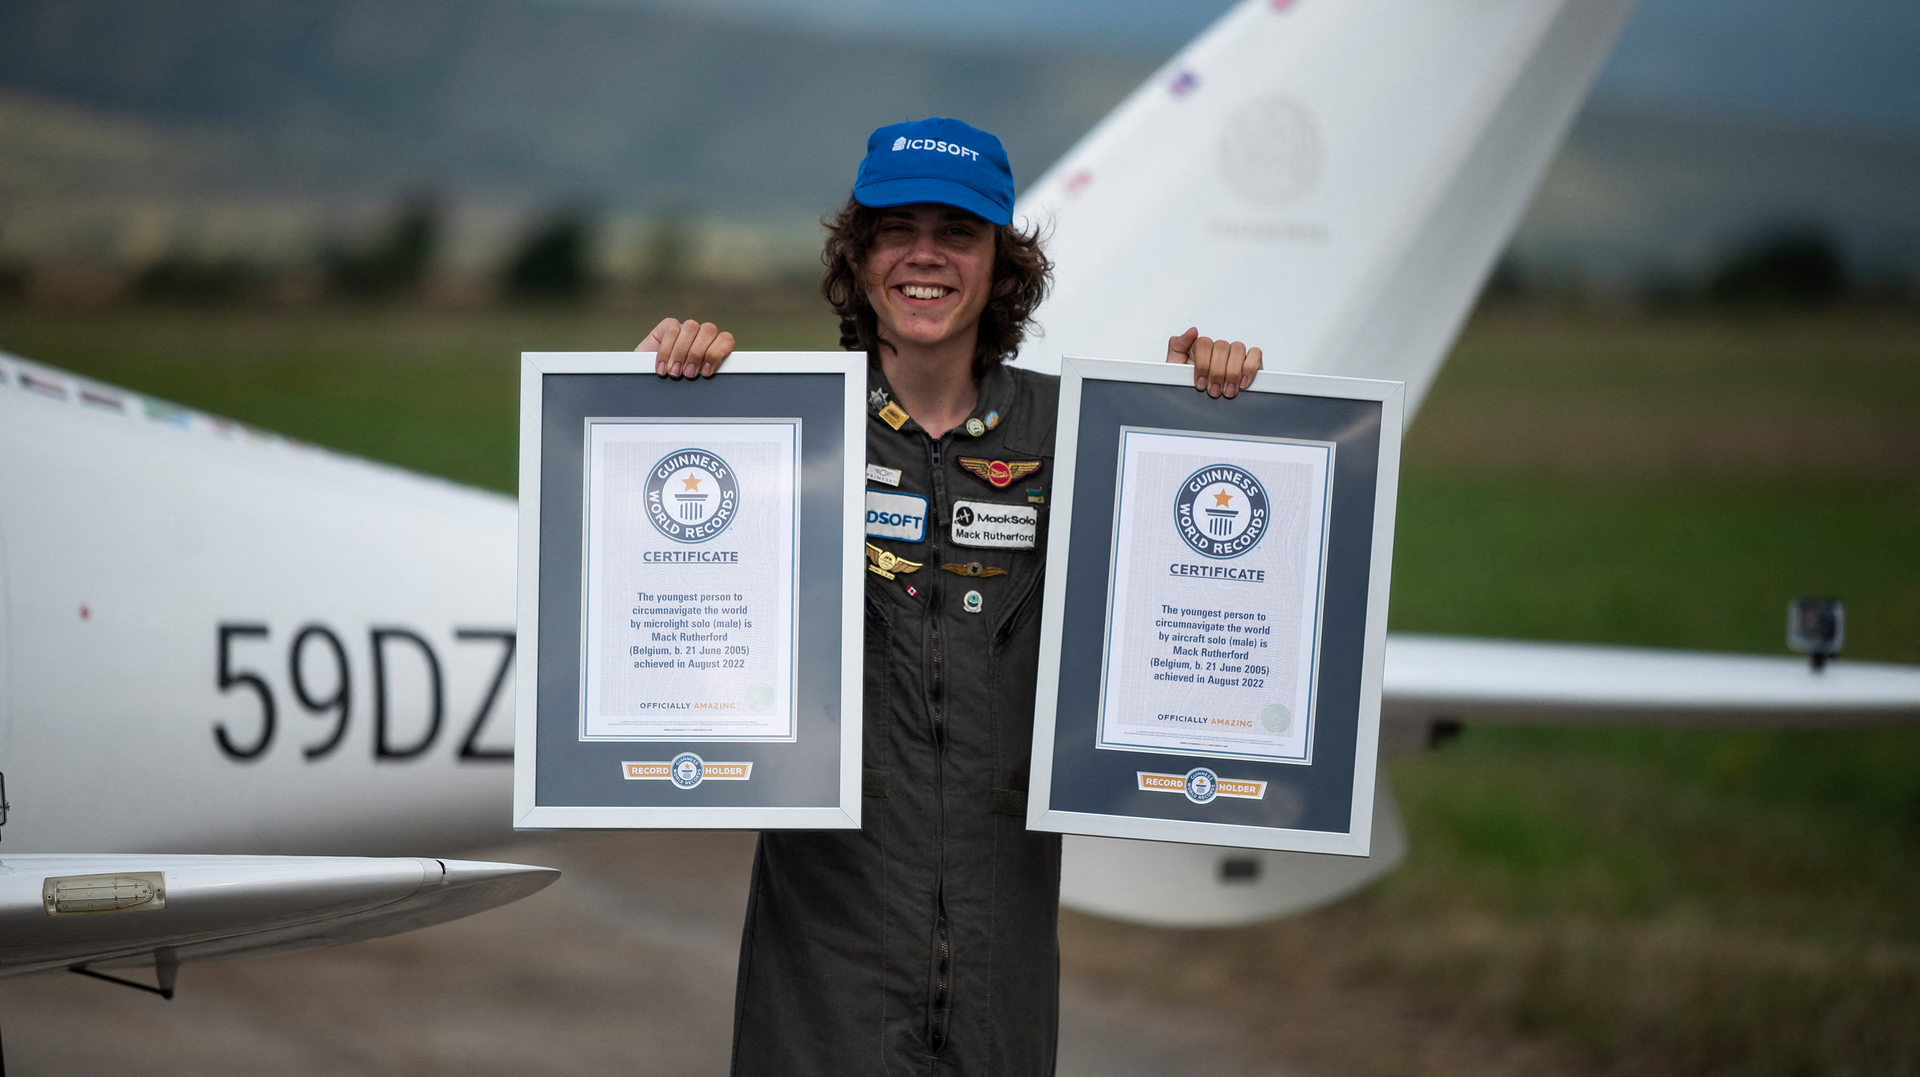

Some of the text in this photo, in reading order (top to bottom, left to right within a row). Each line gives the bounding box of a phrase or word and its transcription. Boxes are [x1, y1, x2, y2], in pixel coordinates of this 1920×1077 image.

[906, 139, 980, 162] ICDSOFT
[657, 454, 726, 480] GUINNESS
[1190, 470, 1258, 497] GUINNESS
[649, 490, 734, 538] WORLD RECORDS
[977, 513, 1036, 526] MackSolo
[956, 528, 1034, 542] Mack Rutherford
[1180, 503, 1264, 554] WORLD RECORDS
[643, 551, 738, 562] CERTIFICATE
[1170, 564, 1265, 581] CERTIFICATE
[638, 592, 743, 603] The youngest person to
[632, 606, 748, 616] circumnavigate the world
[1162, 605, 1266, 621] The youngest person to
[631, 619, 752, 630] by microlight solo (male) is
[1155, 618, 1270, 635] circumnavigate the world
[651, 632, 728, 641] Mack Rutherford
[1159, 631, 1268, 649] by aircraft solo (male) is
[630, 646, 750, 657] (Belgium, b. 21 June 2005)
[1173, 646, 1249, 660] Mack Rutherford
[634, 659, 745, 670] achieved in August 2022
[1150, 657, 1270, 676] (Belgium, b. 21 June 2005)
[1154, 671, 1264, 688] achieved in August 2022
[212, 622, 516, 764] 59DZ
[1157, 714, 1253, 728] OFFICIALLY AMAZING
[676, 757, 698, 766] GUINNESS
[631, 767, 669, 775] RECORD
[1190, 772, 1213, 781] GUINNESS
[1146, 777, 1183, 787] RECORD
[1219, 784, 1256, 793] HOLDER
